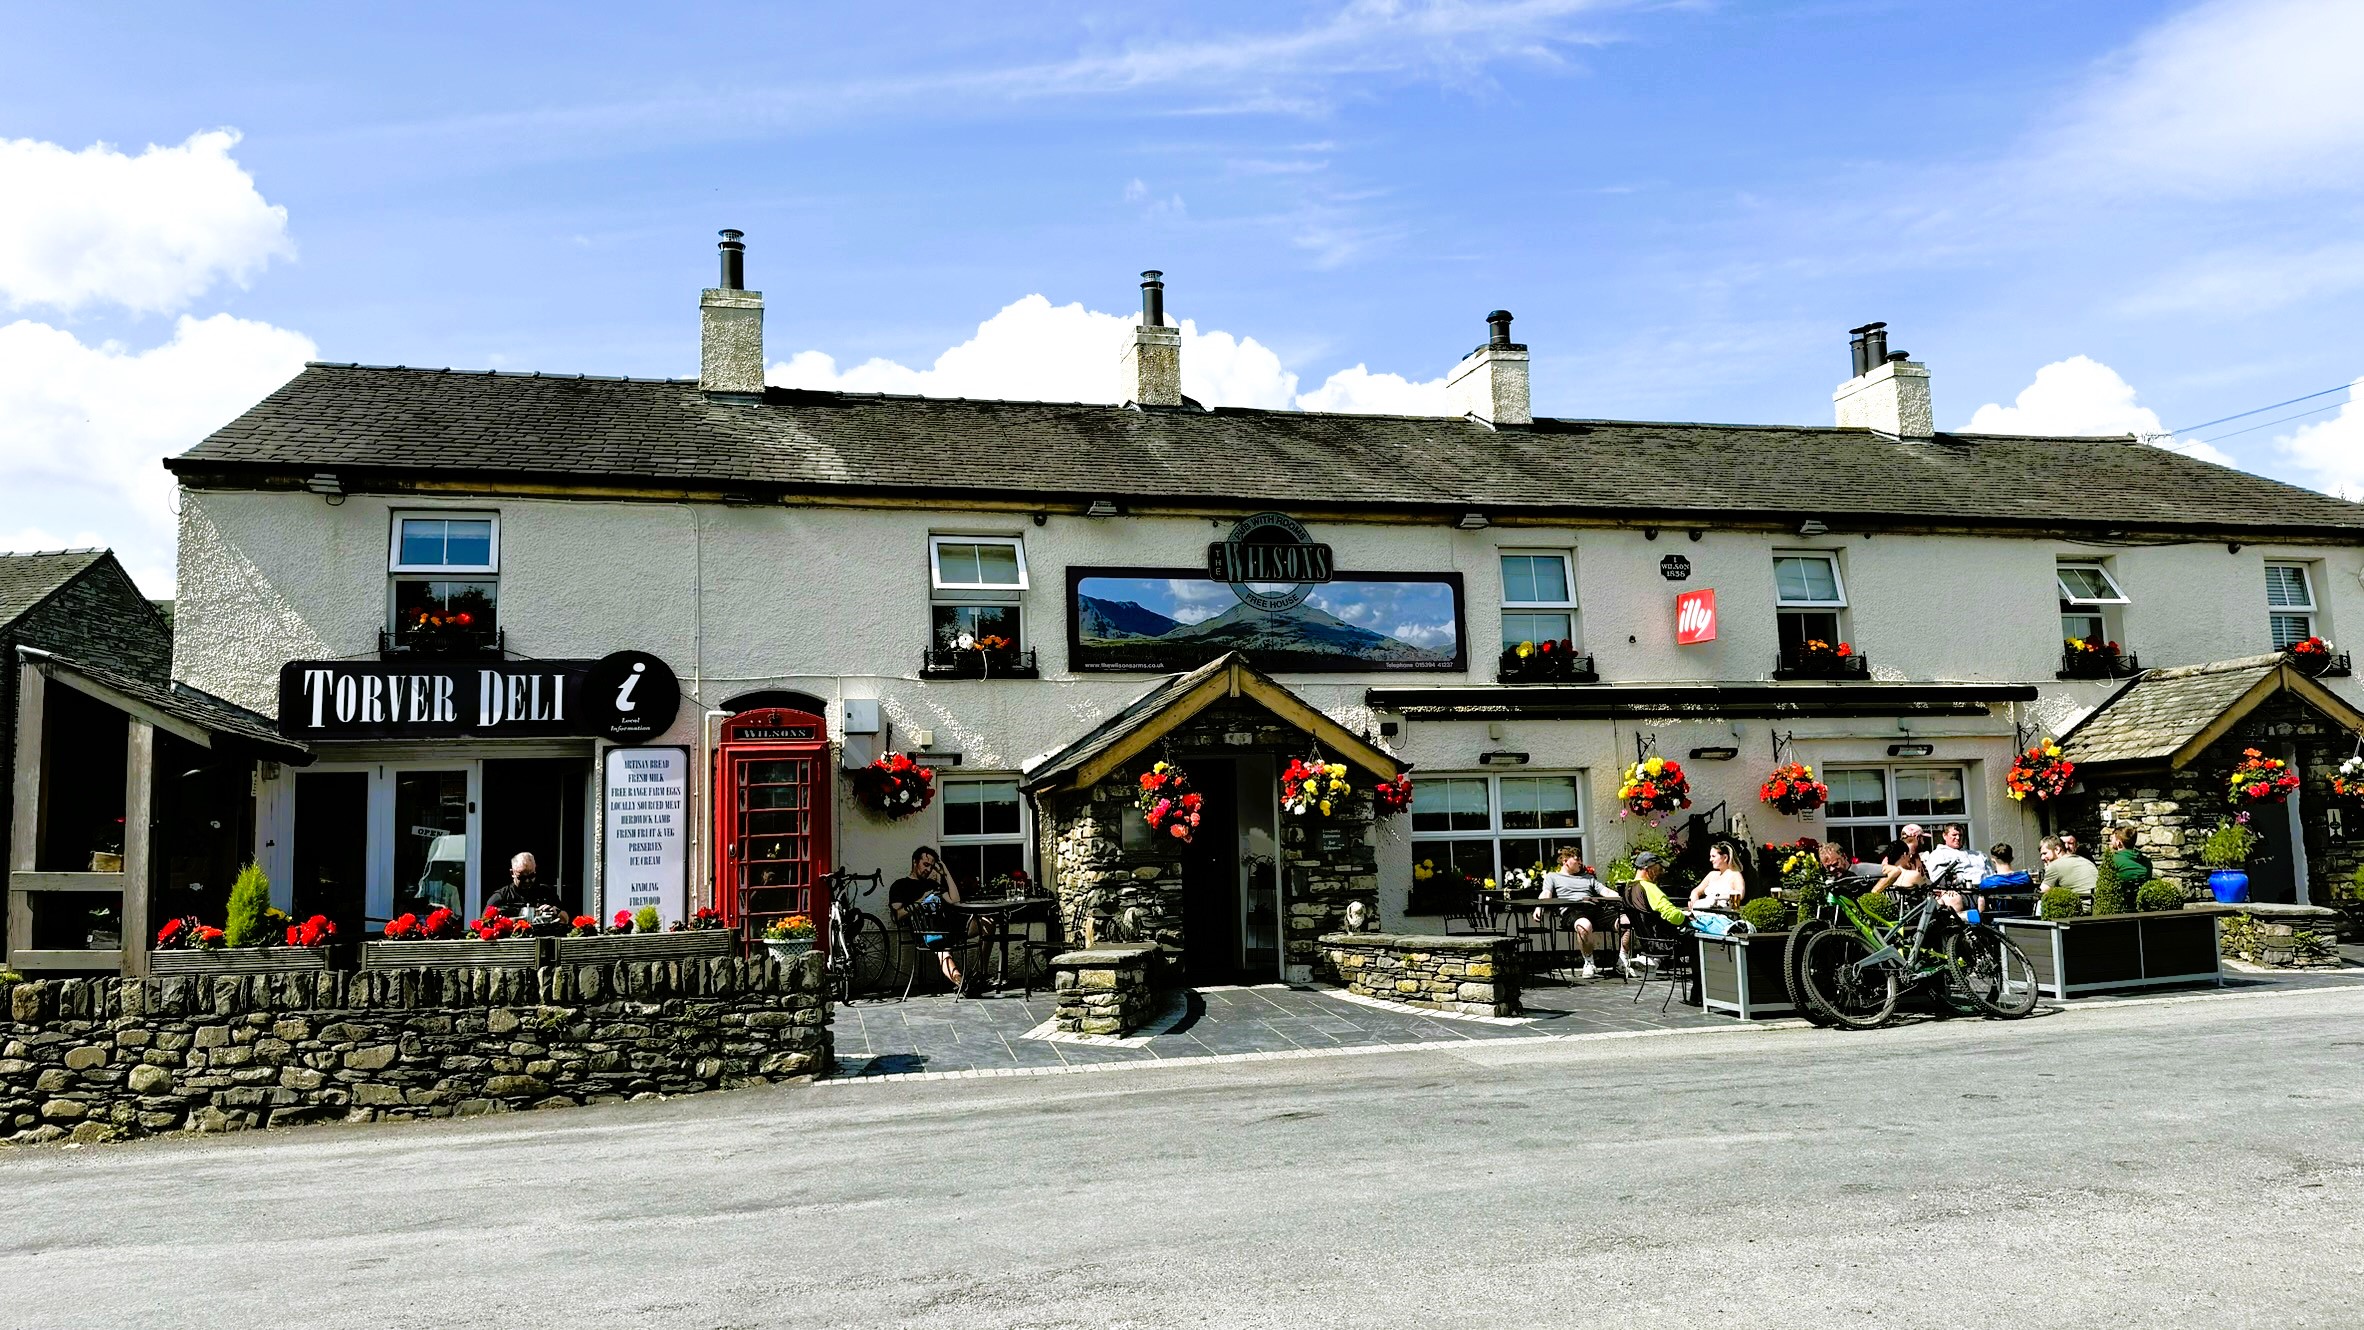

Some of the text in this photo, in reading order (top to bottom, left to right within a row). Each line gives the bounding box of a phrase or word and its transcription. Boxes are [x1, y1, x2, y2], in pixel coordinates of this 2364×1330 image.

[1234, 515, 1307, 540] PUB WITH ROOMS
[1224, 543, 1327, 581] WILSONS
[1245, 593, 1299, 608] FREE HOUSE
[1679, 598, 1712, 638] illy
[303, 670, 565, 727] TORVER DELI
[744, 729, 806, 738] WILSONS
[624, 760, 670, 769] ARTISAN BREAD
[628, 773, 664, 783] FRESH MILK
[611, 787, 681, 797] FREE RANGE FARM EGGS
[610, 800, 680, 811] LOCALLY SOURCED MEAT
[621, 814, 671, 824] HERDWICK LAMB
[417, 829, 443, 837] OPEN
[616, 828, 675, 838] FRESH FRUIT & VEG
[628, 842, 663, 852] PRESERVES
[630, 856, 661, 866] ICE CREAM
[631, 882, 659, 892] KINDLING
[629, 896, 661, 906] FIREWOOD
